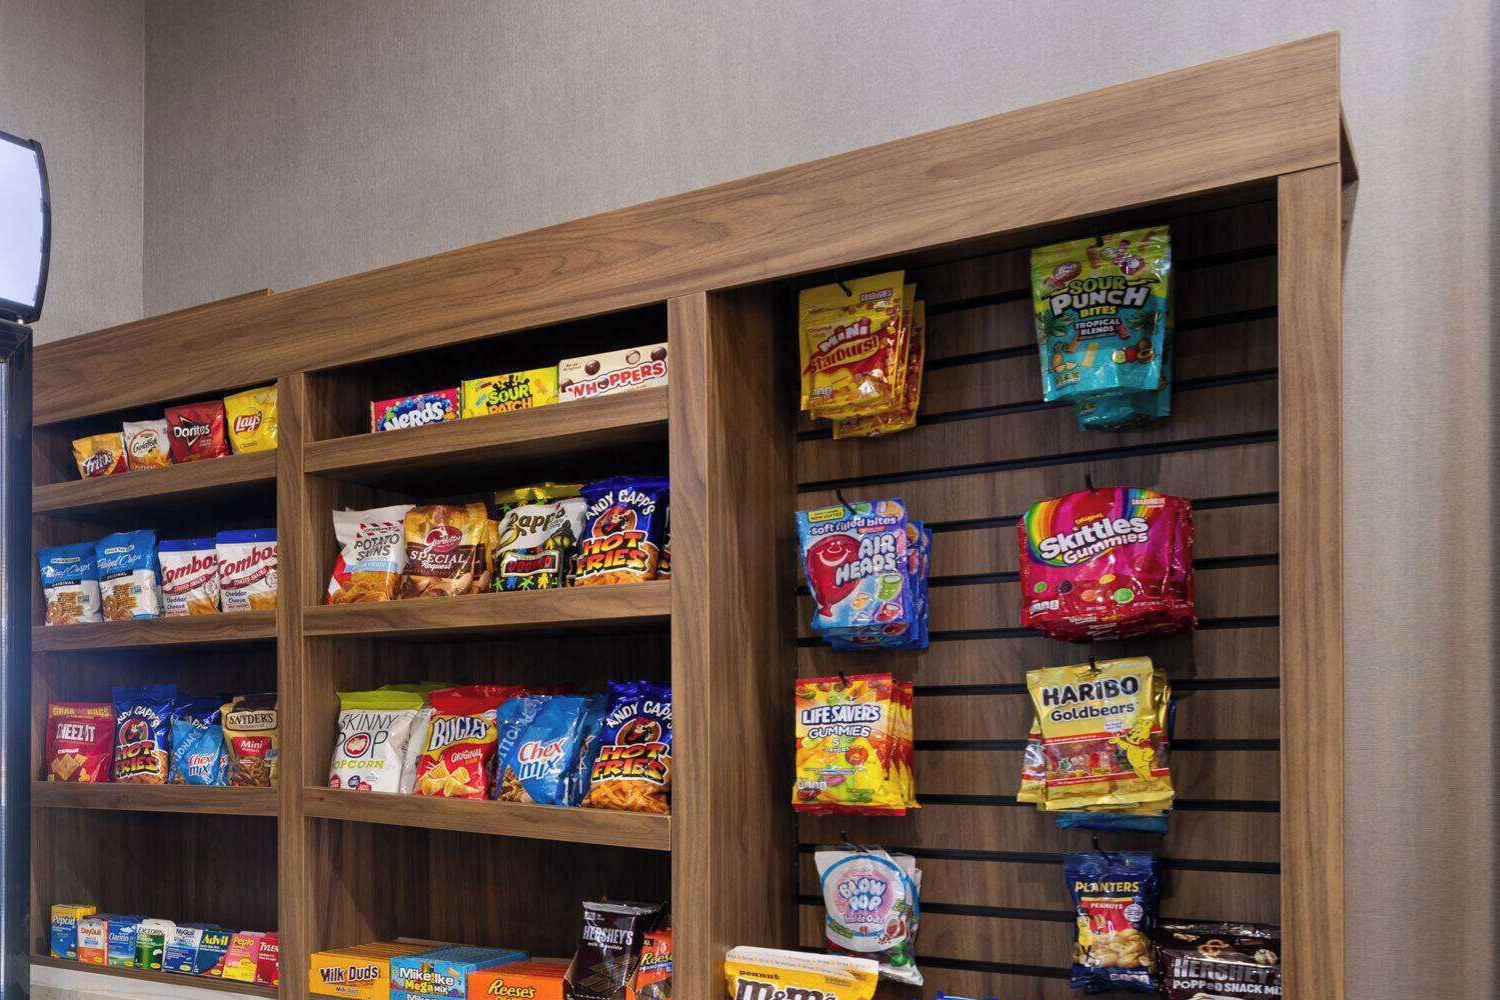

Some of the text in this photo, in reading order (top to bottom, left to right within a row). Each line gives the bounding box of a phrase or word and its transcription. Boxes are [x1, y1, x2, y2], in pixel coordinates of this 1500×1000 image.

[1069, 277, 1127, 295] SOUR
[1051, 287, 1150, 317] PUNCH
[1080, 306, 1116, 318] BITES
[1076, 319, 1121, 329] TROPICAL
[1081, 326, 1115, 336] BLENDS
[572, 361, 665, 398] WHOPPERS
[489, 385, 530, 403] SOUR
[173, 424, 210, 438] Doritos
[236, 413, 262, 432] Lay's
[83, 451, 113, 475] Fritos
[585, 489, 656, 521] ANDY CAPP'S
[811, 516, 897, 536] soft filled bites
[583, 531, 644, 554] HOT
[859, 534, 896, 560] AIR
[1040, 517, 1149, 559] Skittles
[409, 550, 465, 563] SPECIAL
[1063, 533, 1149, 564] Gummies
[421, 560, 453, 572] Request
[577, 549, 648, 575] FRIES
[835, 552, 897, 586] HEADS
[1042, 676, 1140, 707] HARIBO
[229, 714, 273, 724] SNYDER'S
[606, 701, 639, 728] ANDY
[1051, 703, 1136, 722] Goldbears
[340, 713, 400, 731] SKINNY
[429, 716, 489, 751] BUGLES
[808, 726, 871, 740] GUMMIES
[117, 742, 154, 761] HOT
[240, 739, 263, 749] Mini
[518, 740, 565, 762] Chex
[601, 743, 665, 761] HOT
[115, 757, 159, 776] FRIES
[187, 753, 213, 766] Chex
[592, 759, 664, 780] FRIES
[839, 877, 887, 899] BLOW
[1075, 881, 1140, 893] PLANTERS
[849, 894, 883, 912] POP
[1090, 902, 1123, 910] PEANUTS
[53, 915, 76, 926] Pepcid
[109, 932, 129, 942] Claritin
[203, 934, 229, 946] Advil
[234, 936, 255, 947] Pepto
[583, 926, 634, 945] HERSHEY'S
[320, 963, 379, 983] Milk Duds
[400, 967, 431, 982] Mike
[739, 968, 780, 980] peanut
[405, 979, 434, 994] Mega
[488, 979, 536, 998] Reese's
[1224, 983, 1262, 993] SNACK
